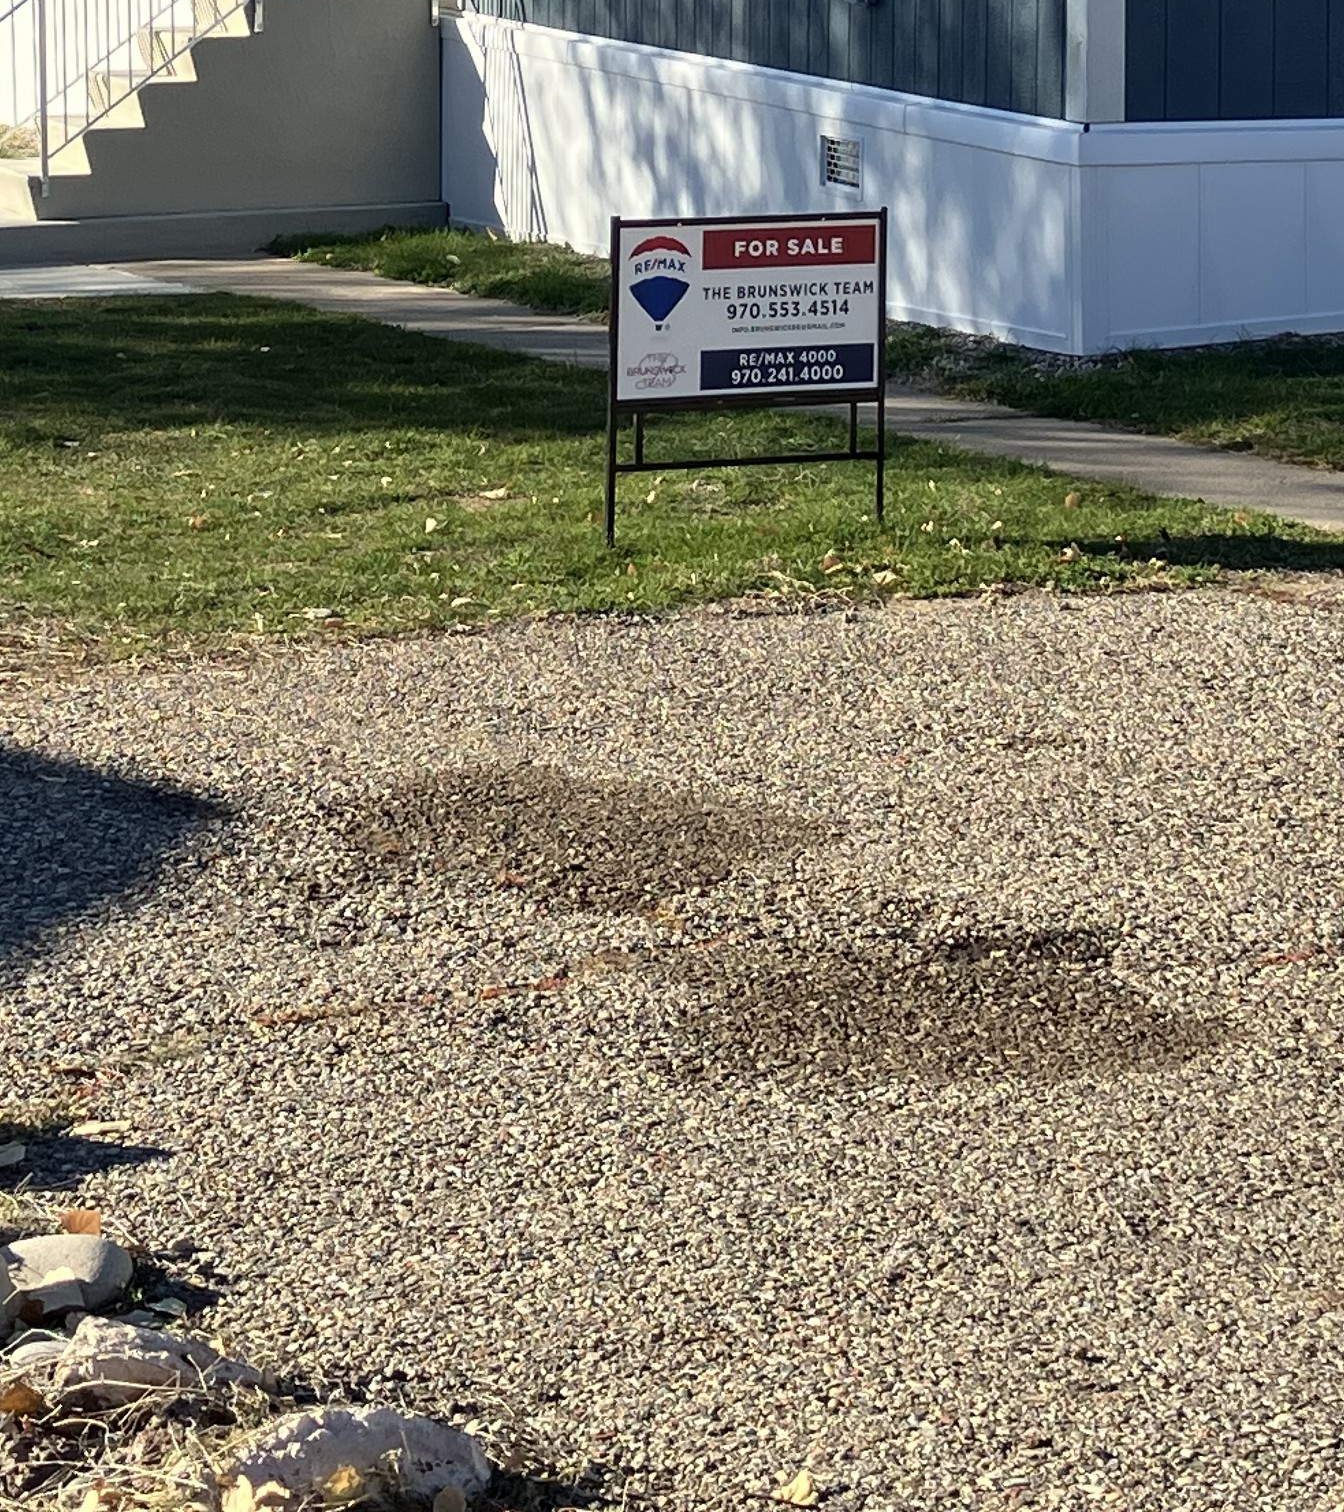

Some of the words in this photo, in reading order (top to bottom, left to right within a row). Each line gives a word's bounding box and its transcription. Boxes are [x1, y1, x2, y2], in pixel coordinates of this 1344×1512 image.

[734, 241, 779, 258] FOR
[787, 237, 844, 255] SALE
[634, 258, 687, 275] RE/MAX
[703, 287, 731, 300] THE
[737, 282, 828, 299] BRUNSWICK
[834, 281, 874, 294] TEAM
[726, 299, 850, 320] 970.553.4514
[739, 352, 794, 366] RE/MAX
[798, 350, 836, 363] 4000
[731, 365, 844, 384] 970.241.4000
